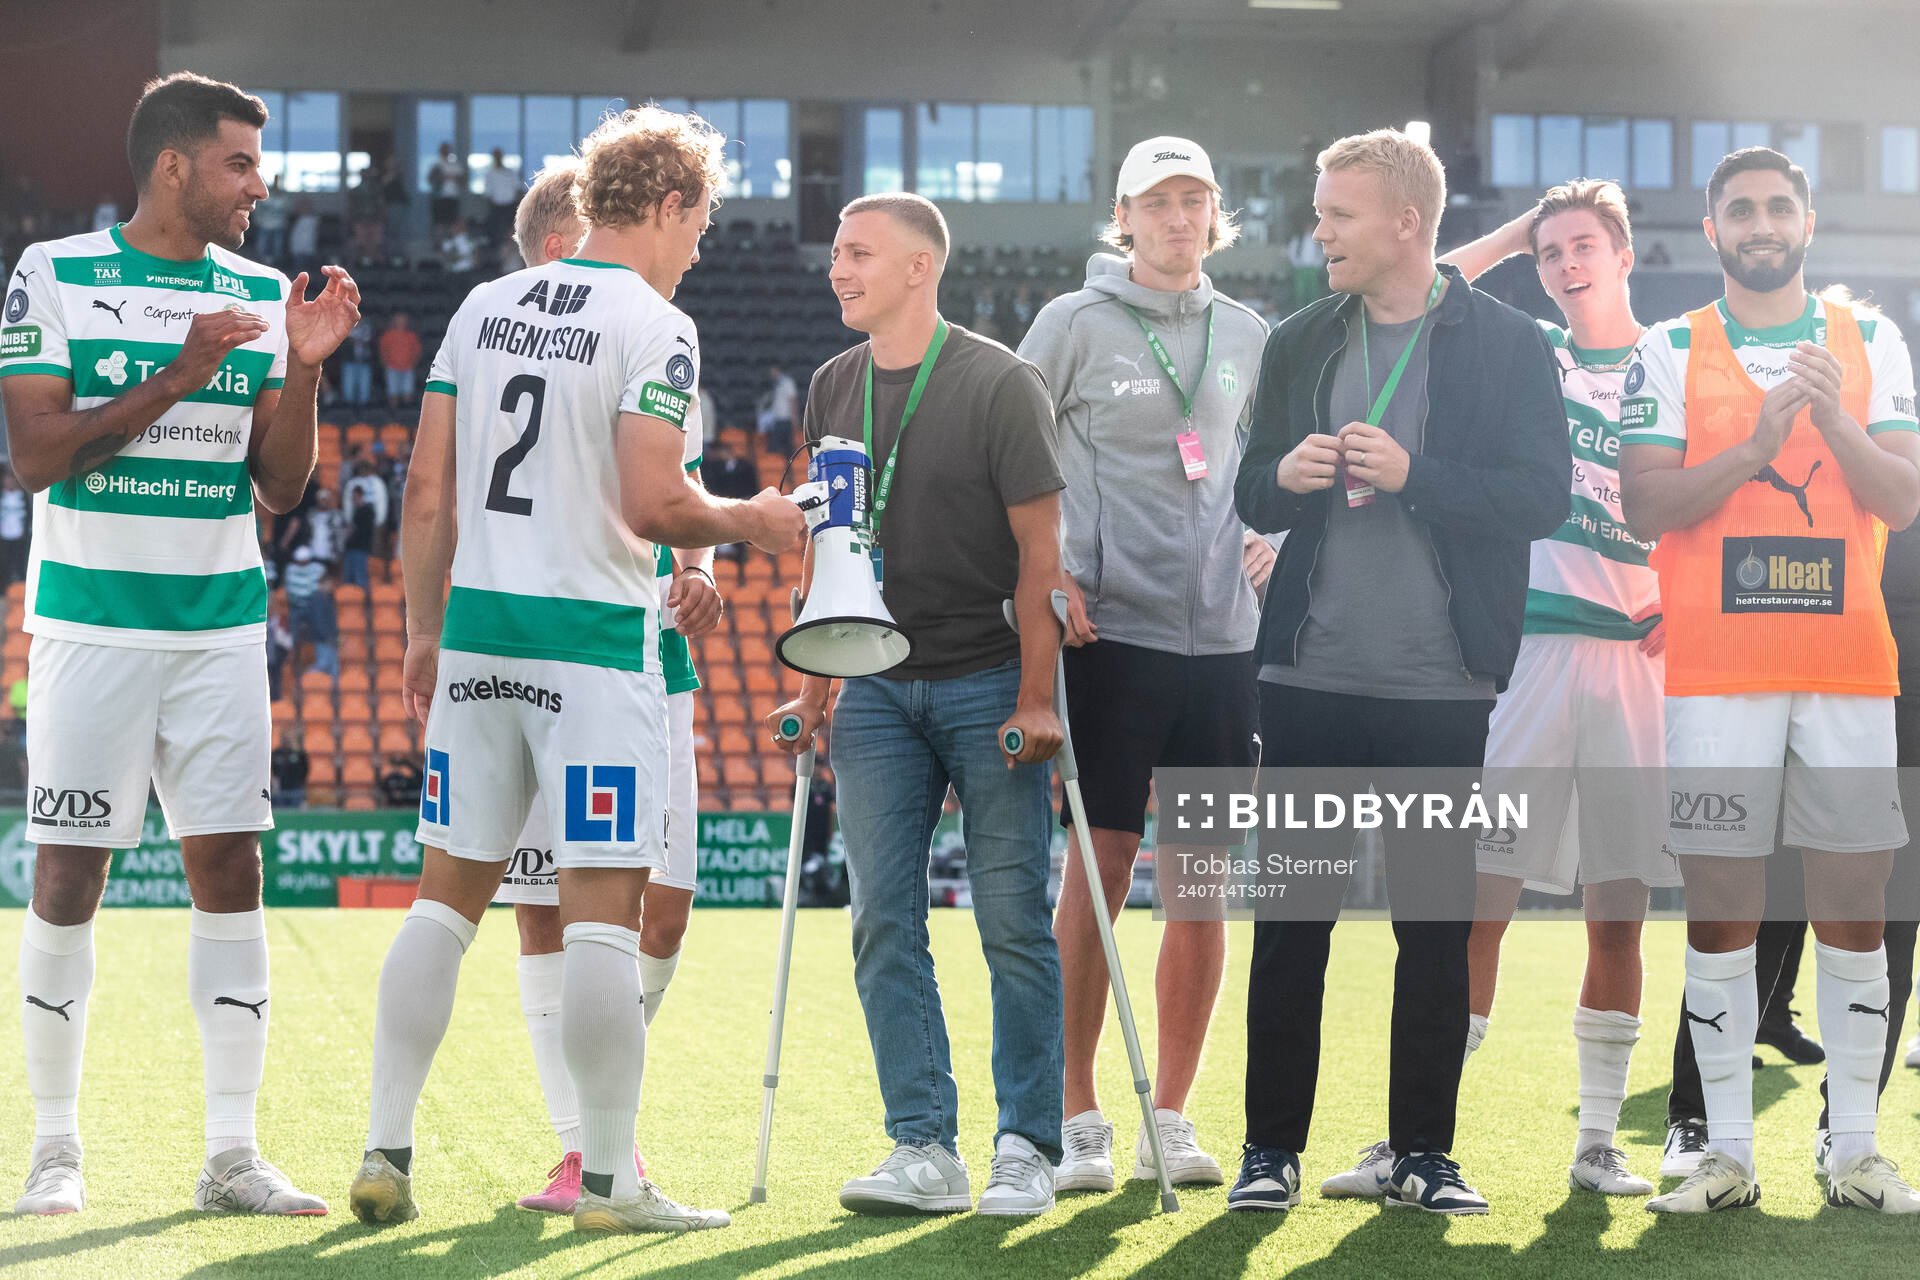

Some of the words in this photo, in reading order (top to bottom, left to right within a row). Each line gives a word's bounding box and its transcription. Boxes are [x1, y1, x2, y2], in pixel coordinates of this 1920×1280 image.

[1152, 151, 1191, 163] Titleist
[93, 268, 122, 279] TAK
[154, 275, 203, 288] INTERSPORT
[135, 360, 250, 395] Txia
[1131, 379, 1160, 387] INTER
[1131, 386, 1160, 395] SPORT
[136, 423, 242, 444] ygienteknik
[1567, 417, 1620, 457] Tele
[485, 374, 547, 517] 2
[109, 475, 180, 497] Hitachi
[184, 479, 236, 502] Energ
[1768, 555, 1833, 592] Heat
[1735, 596, 1833, 607] heatrestauranger.se
[449, 675, 563, 714] axelssons
[33, 786, 112, 819] RYDS
[1671, 791, 1748, 822] RYDS
[59, 820, 111, 828] BILGLAS
[703, 820, 770, 843] HELA
[1694, 823, 1746, 831] BILGLAS
[277, 830, 385, 864] SKYLT
[391, 830, 420, 864] &
[1476, 844, 1514, 854] LGLAS
[698, 848, 790, 871] TADENS
